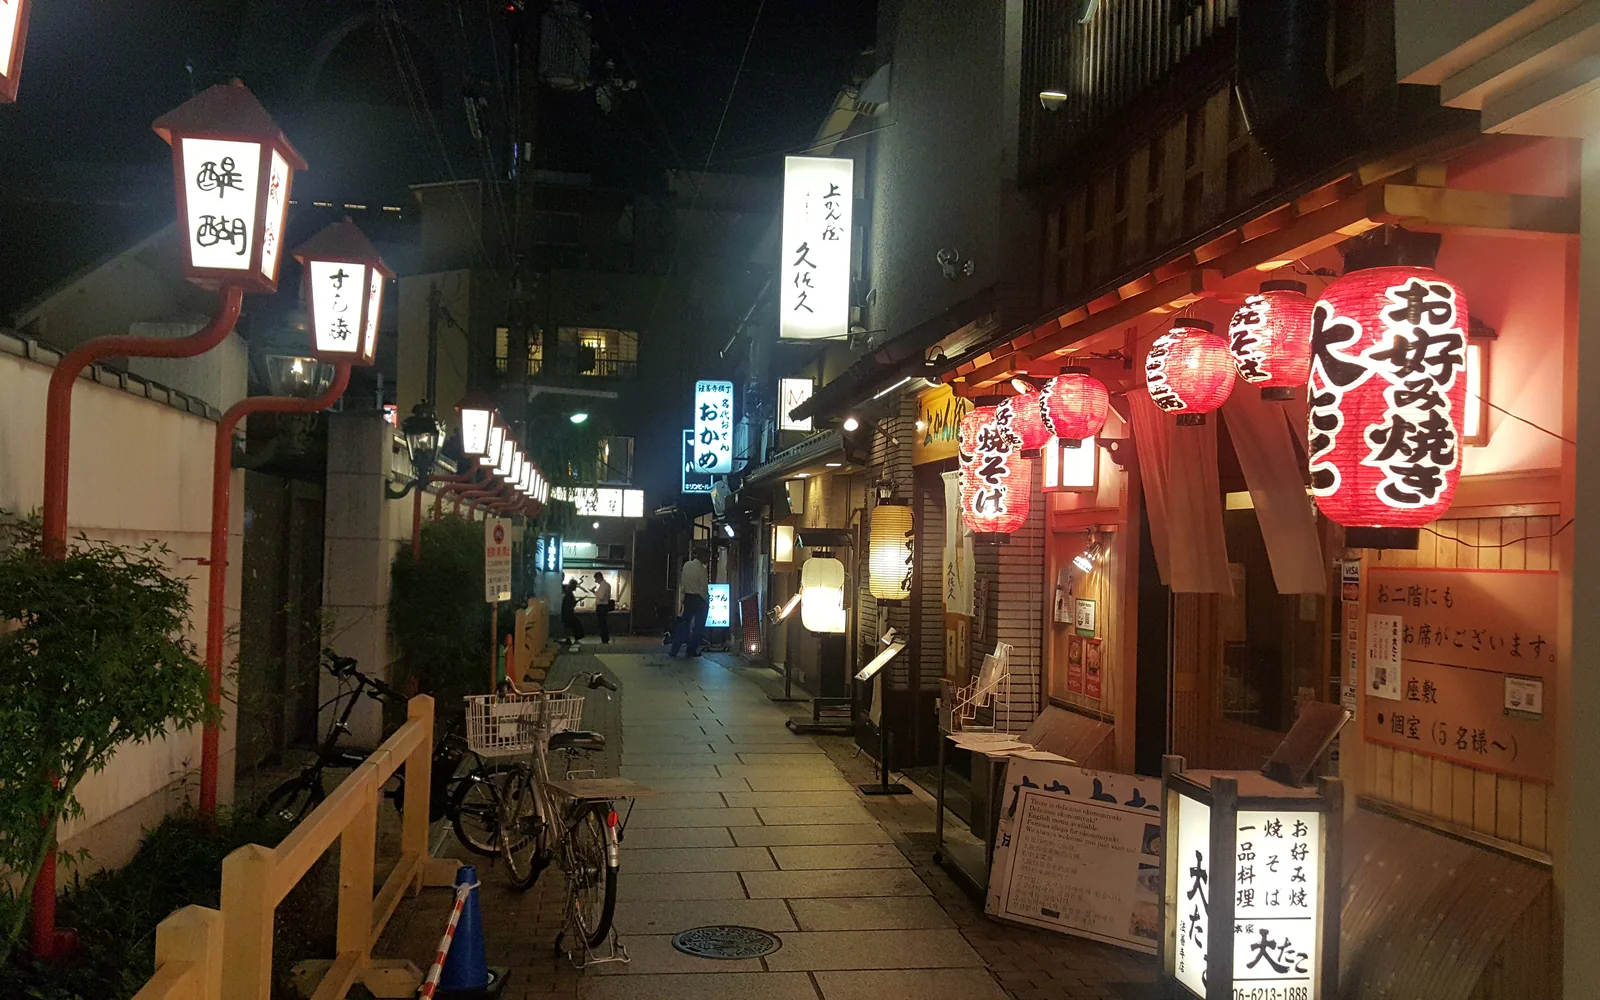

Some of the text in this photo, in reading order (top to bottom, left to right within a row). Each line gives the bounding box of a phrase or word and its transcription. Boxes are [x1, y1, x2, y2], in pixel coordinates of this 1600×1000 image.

[1369, 279, 1464, 504] お好み焼き
[698, 402, 720, 469] おかめ
[1345, 566, 1358, 574] VISA
[1377, 584, 1454, 609] お二階にも
[1405, 677, 1438, 704] 座敷
[1028, 812, 1050, 822] English
[1051, 818, 1069, 826] menu
[1236, 825, 1256, 908] 一品料理
[1288, 819, 1310, 908] お好み焼
[1246, 928, 1308, 974] 大たこ
